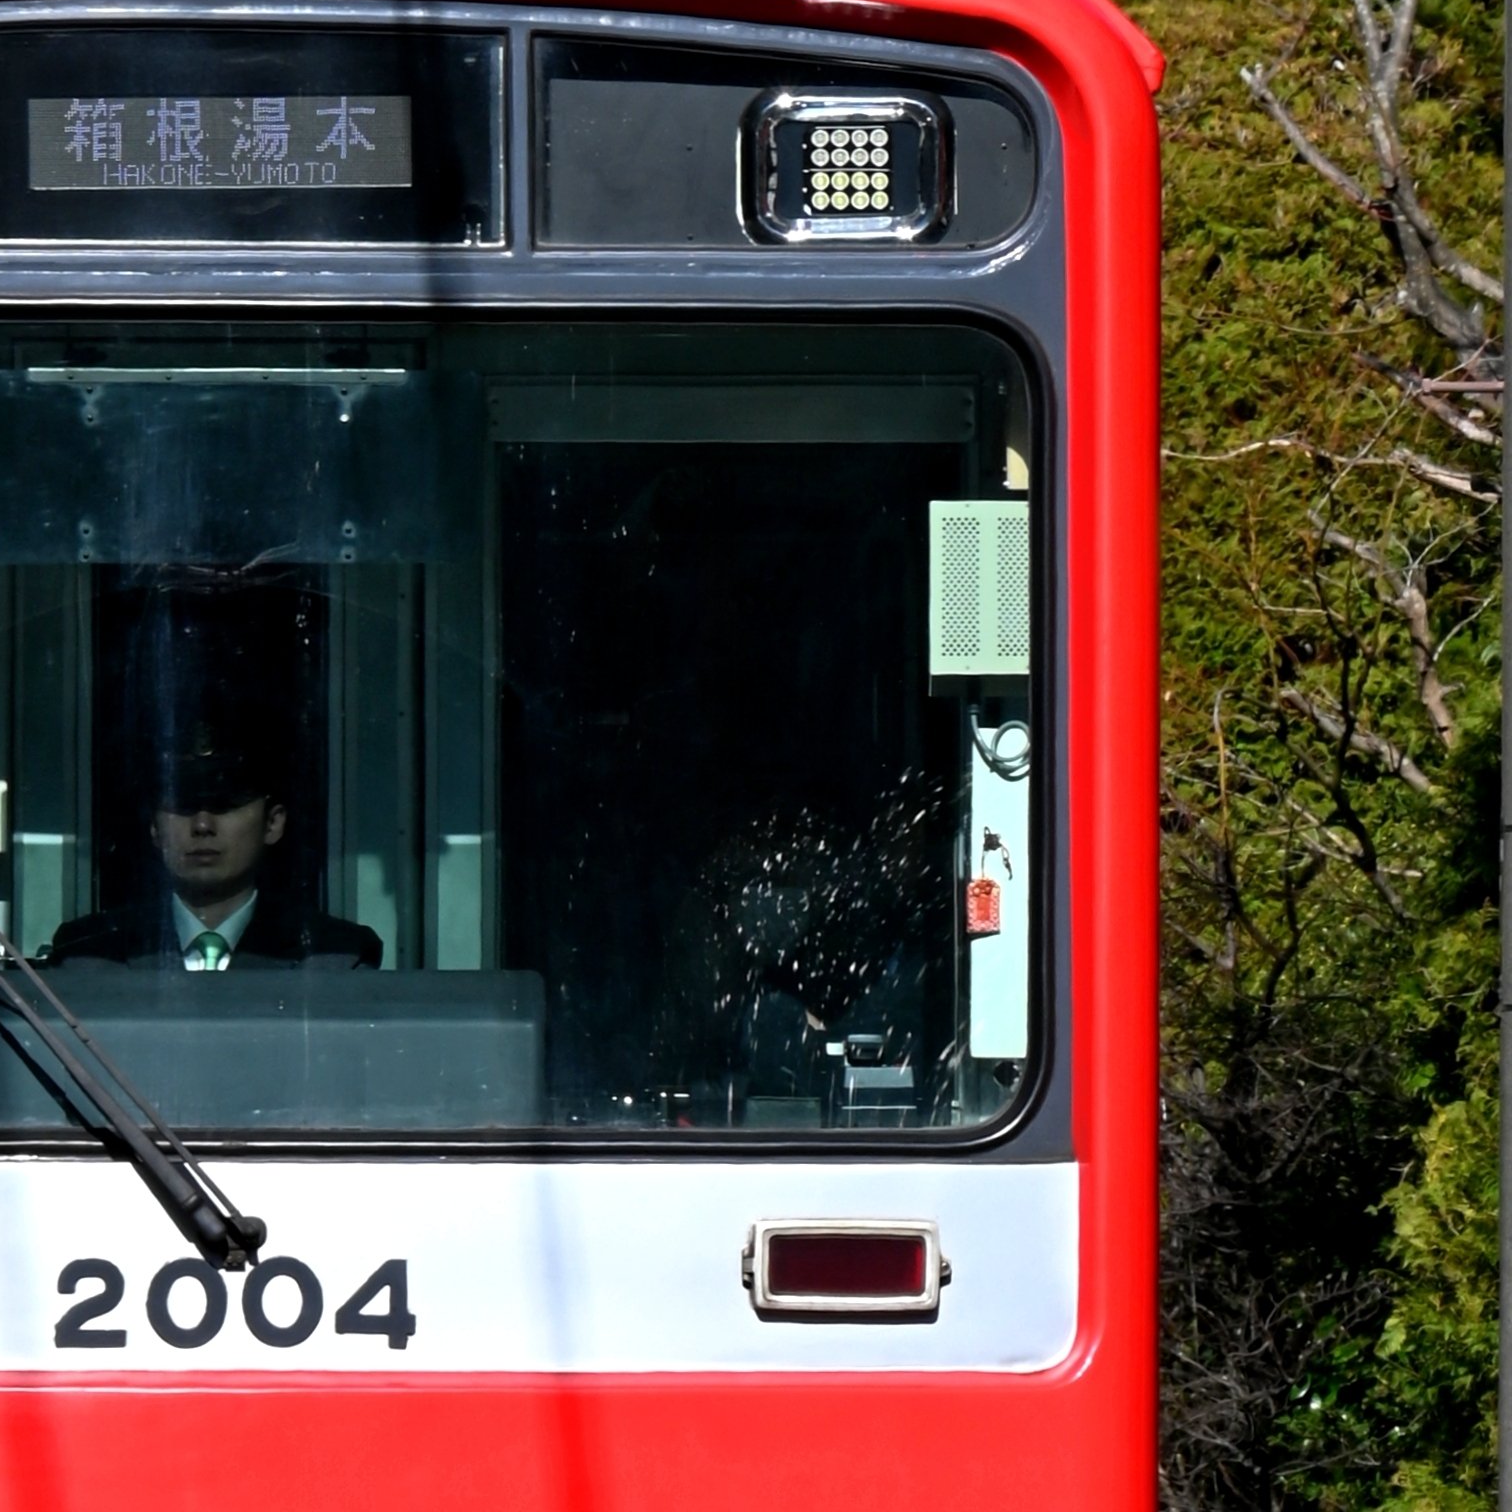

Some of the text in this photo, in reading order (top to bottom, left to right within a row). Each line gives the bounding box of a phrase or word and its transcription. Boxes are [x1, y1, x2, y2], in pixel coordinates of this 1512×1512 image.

[64, 97, 376, 162] 箱根湯本
[102, 162, 337, 186] HAKONE-YUMOTO
[54, 1256, 417, 1349] 2004
